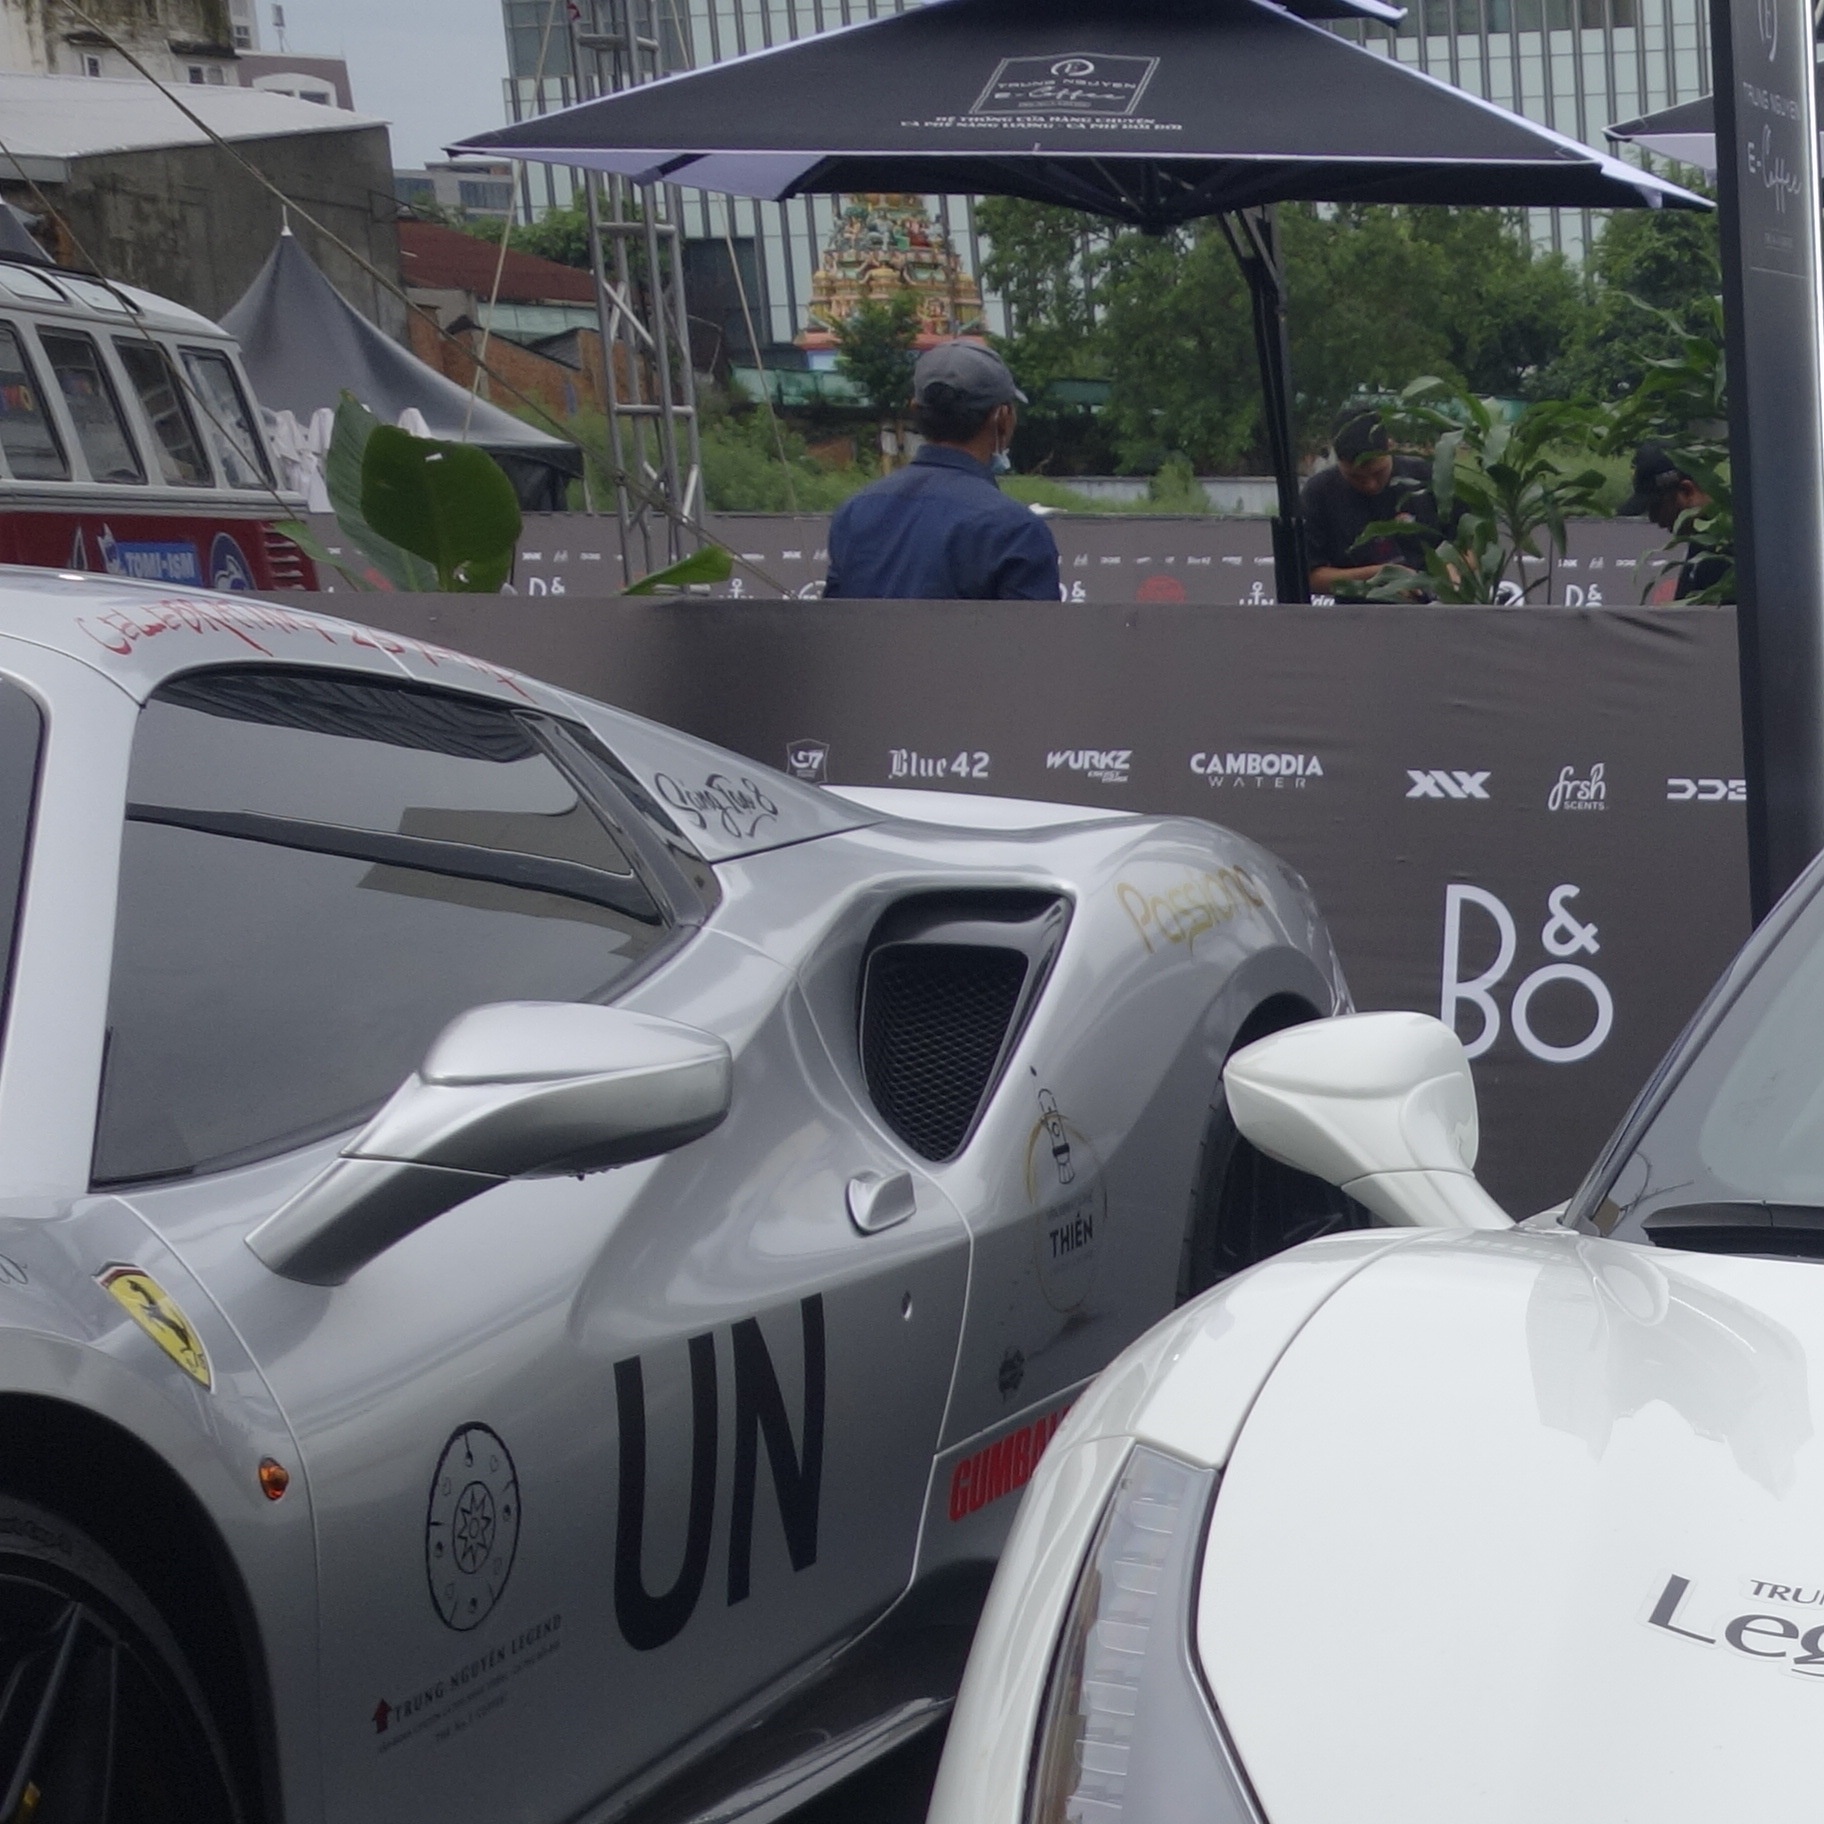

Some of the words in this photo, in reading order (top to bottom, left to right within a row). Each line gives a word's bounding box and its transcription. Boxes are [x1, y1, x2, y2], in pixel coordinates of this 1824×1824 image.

[790, 748, 825, 770] G7
[1046, 749, 1133, 770] WURKZ
[1189, 753, 1324, 777] CAMBODIA
[1208, 776, 1306, 789] WATER
[1563, 800, 1606, 812] SCENTS
[612, 1292, 829, 1654] UN
[394, 1681, 444, 1723] TRUNG
[449, 1645, 506, 1690] NGUYÊN
[511, 1614, 562, 1655] LEGEND
